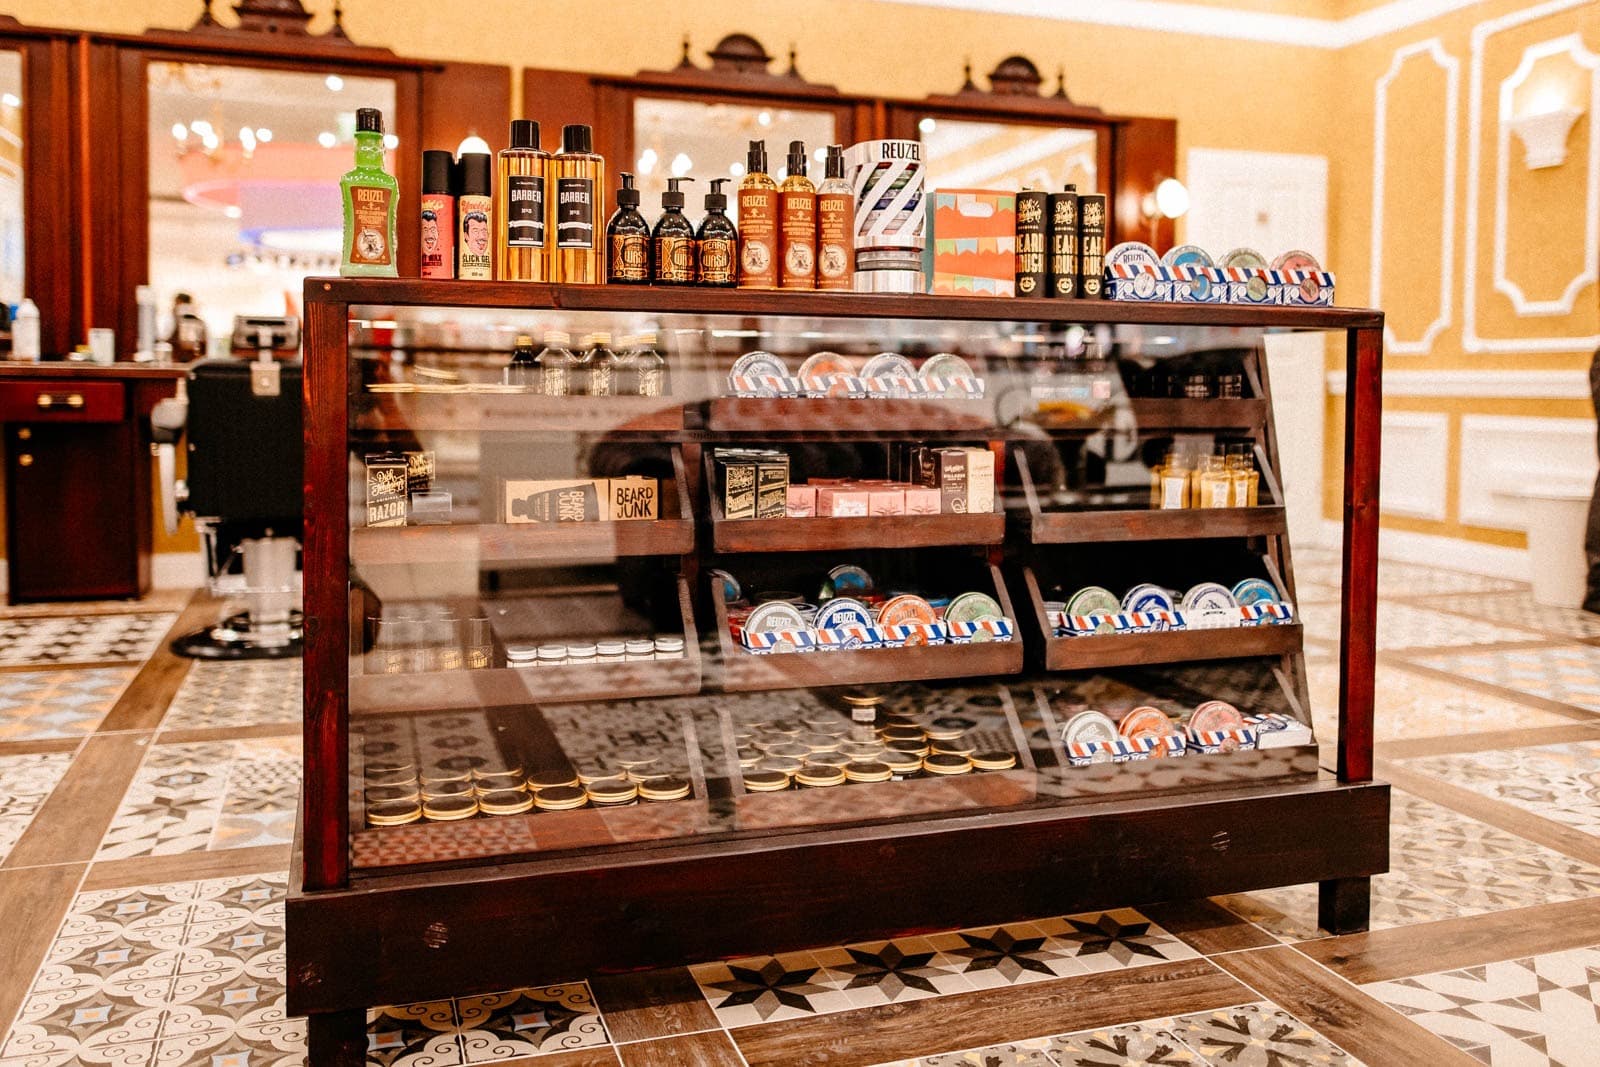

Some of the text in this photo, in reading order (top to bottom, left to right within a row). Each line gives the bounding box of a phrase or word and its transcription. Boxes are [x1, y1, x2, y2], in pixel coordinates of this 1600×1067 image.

[882, 142, 921, 161] REUZEL
[357, 189, 384, 202] REUZEL
[511, 190, 542, 204] BARBER
[560, 191, 590, 205] BARBER
[742, 195, 769, 208] REUZEL
[787, 198, 813, 210] REUZEL
[820, 199, 845, 212] REUZEL
[703, 254, 727, 268] WASH
[616, 487, 654, 506] BEARD
[369, 500, 405, 522] RAZOR
[558, 491, 575, 521] JUNK
[570, 491, 585, 522] BEARD
[617, 500, 652, 519] JUNK
[832, 611, 858, 624] REUZEL
